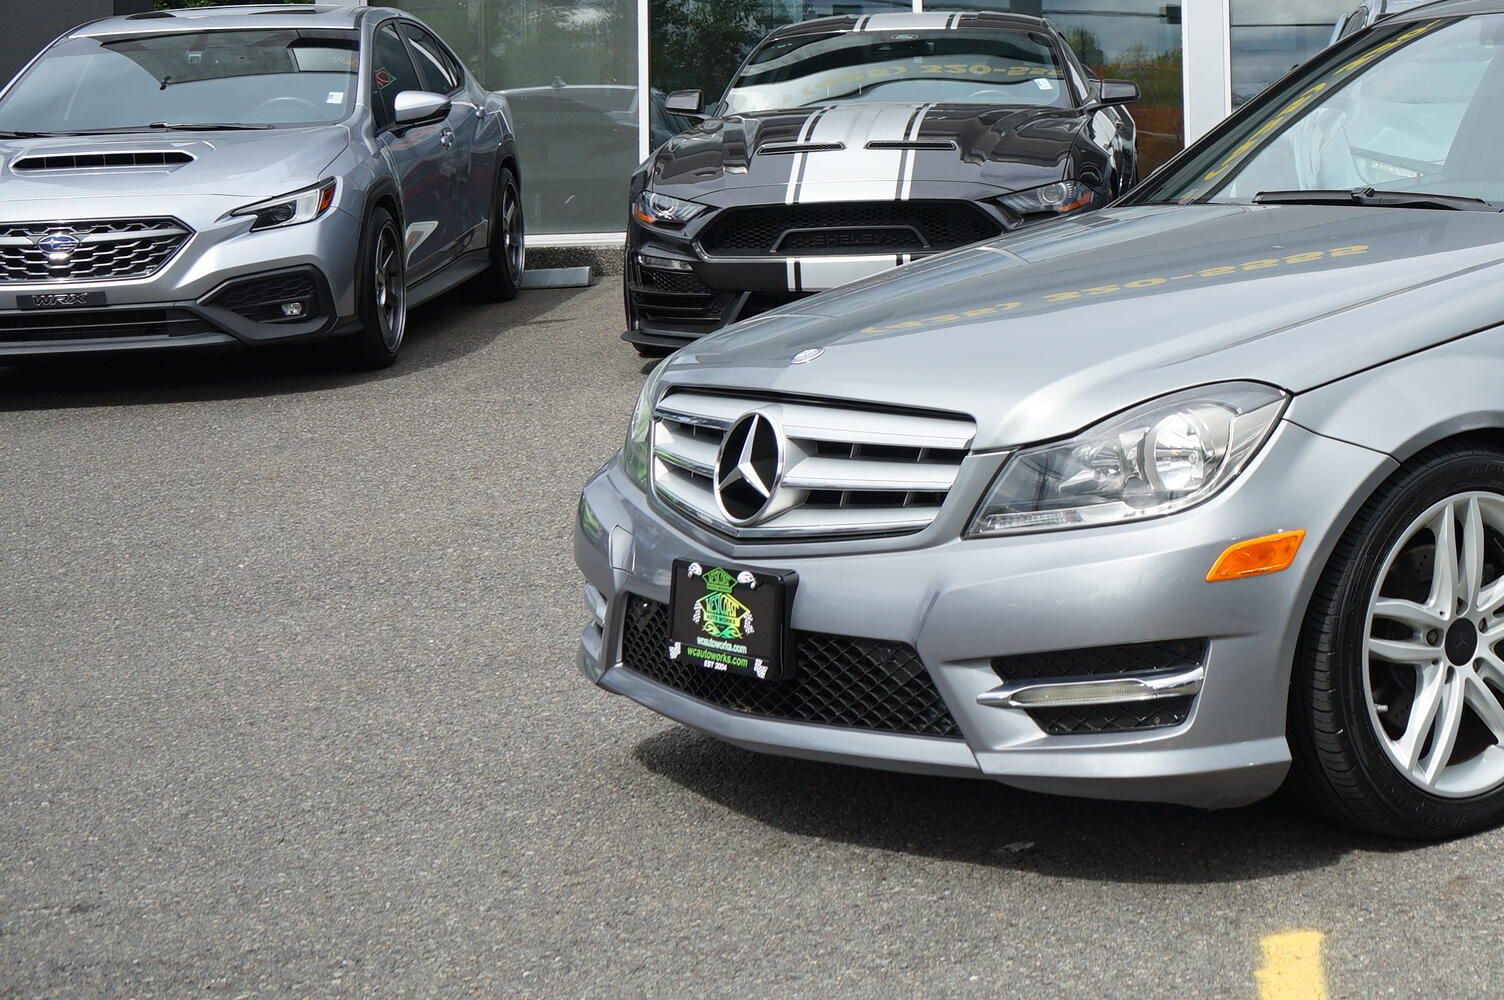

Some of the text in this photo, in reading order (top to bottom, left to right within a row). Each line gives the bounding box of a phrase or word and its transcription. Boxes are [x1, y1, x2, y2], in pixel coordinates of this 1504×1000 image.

[32, 292, 88, 307] WRX
[687, 647, 749, 669] wcautoworks.com
[703, 660, 715, 669] EST
